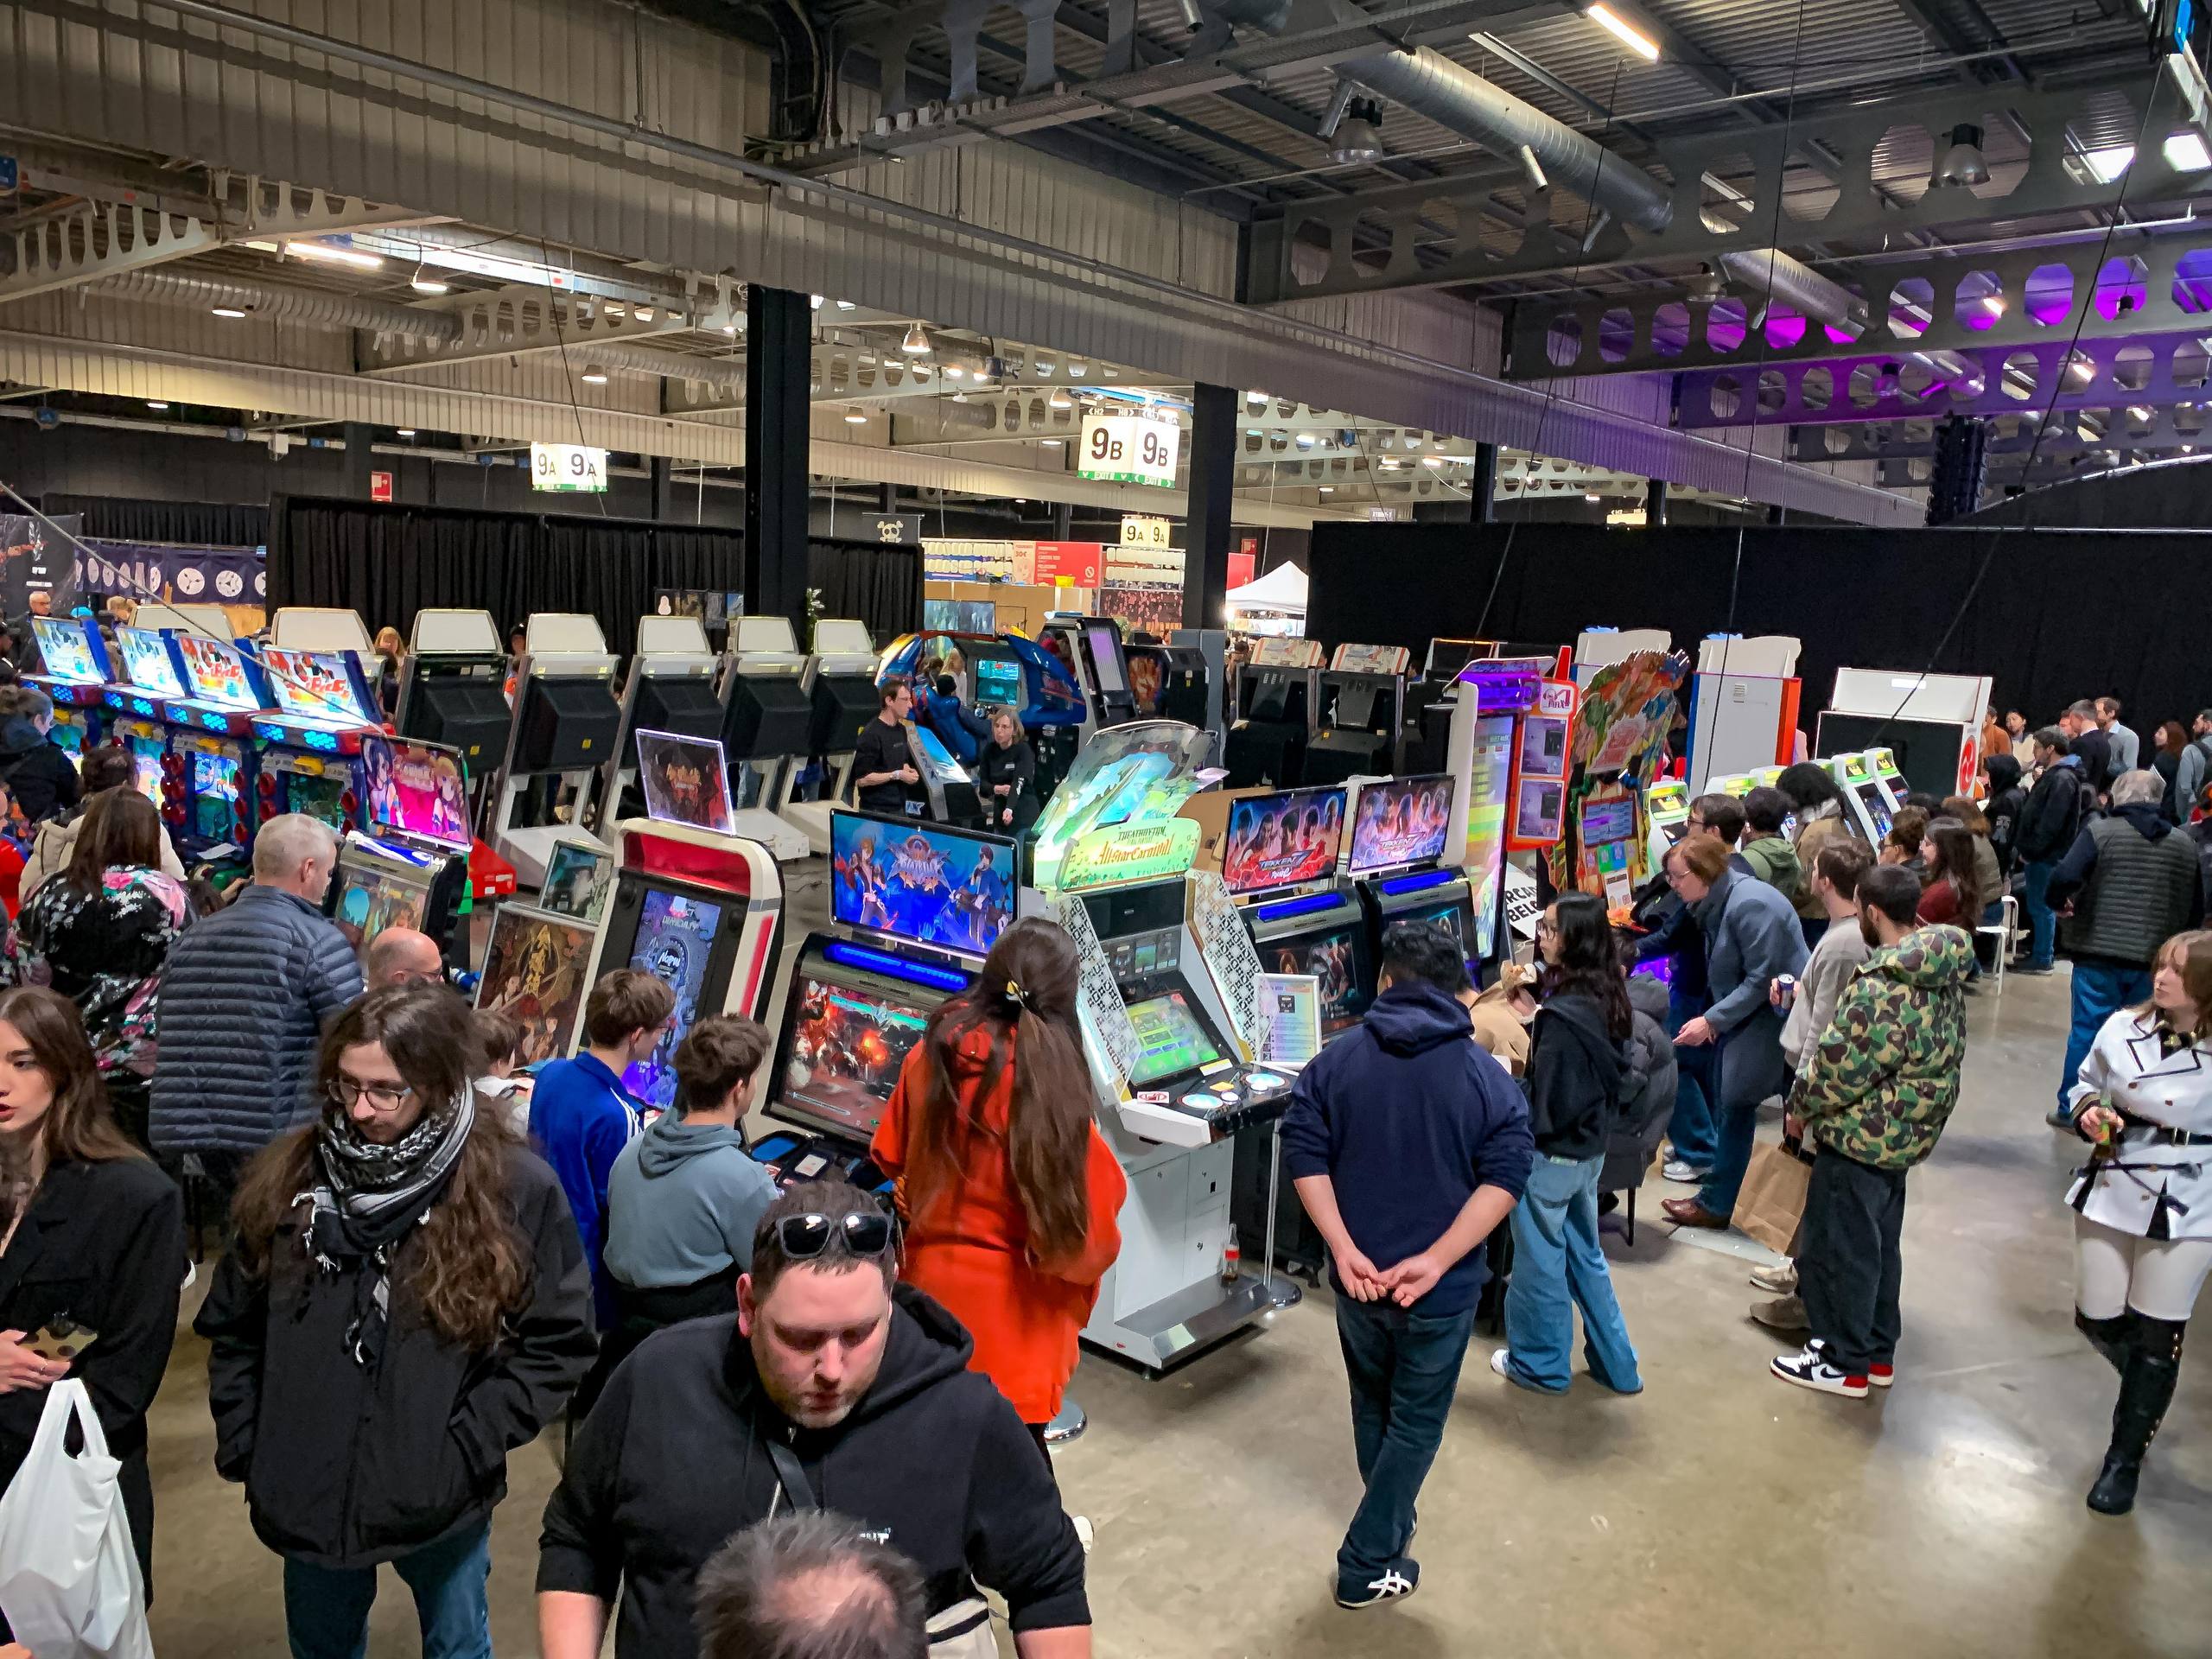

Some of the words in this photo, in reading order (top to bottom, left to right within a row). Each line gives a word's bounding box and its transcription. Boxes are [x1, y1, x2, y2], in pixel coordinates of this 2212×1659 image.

[1091, 427, 1123, 460] 9B
[1143, 432, 1168, 467] 9B
[538, 453, 556, 475] 9A
[571, 453, 596, 476] 9A
[1127, 525, 1143, 541] 9A
[1153, 526, 1165, 543] 9A
[1260, 856, 1294, 869] TEKKEN
[1292, 849, 1313, 867] 7
